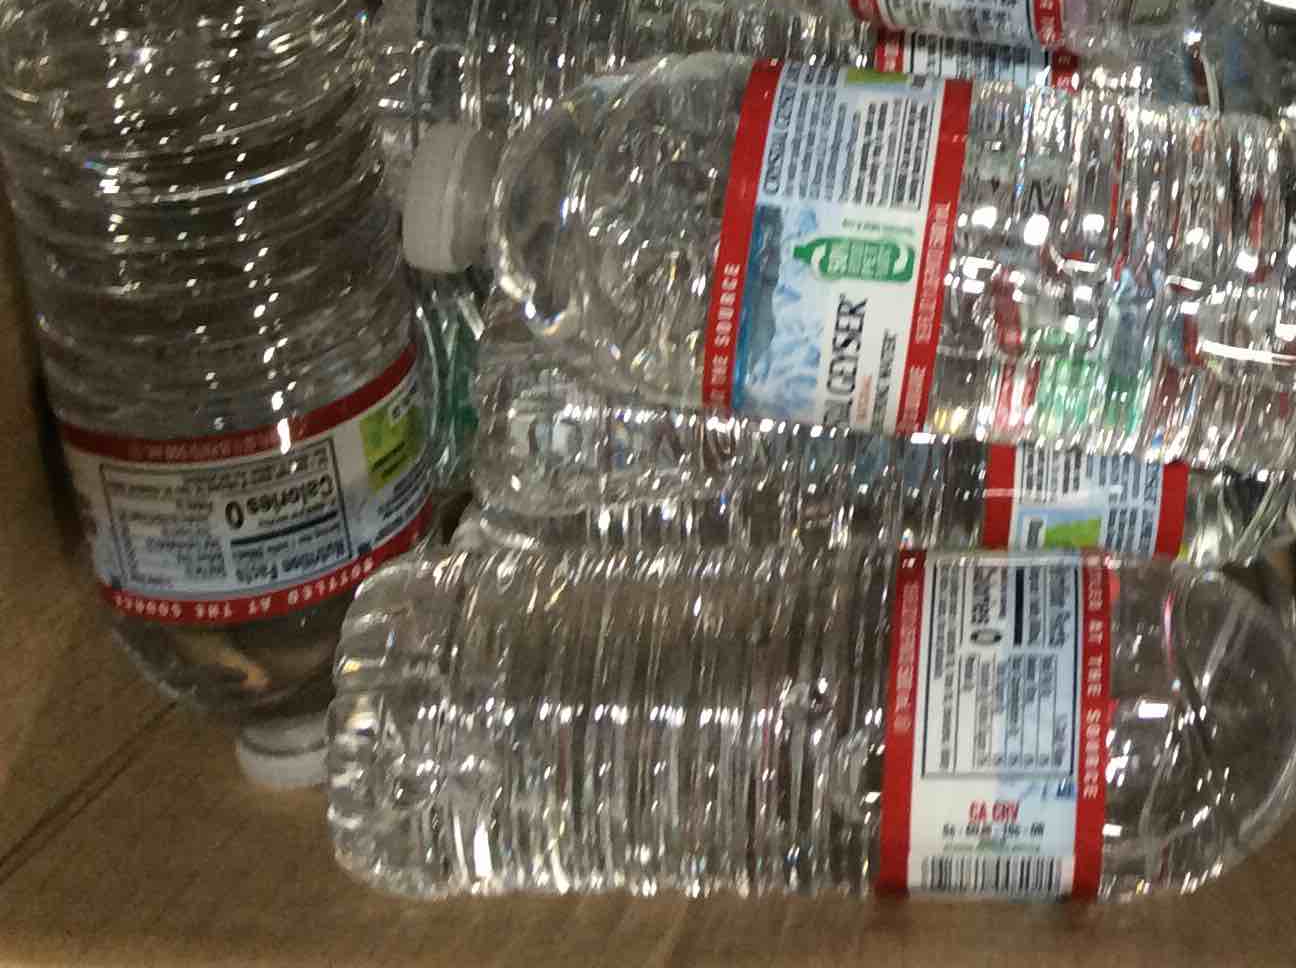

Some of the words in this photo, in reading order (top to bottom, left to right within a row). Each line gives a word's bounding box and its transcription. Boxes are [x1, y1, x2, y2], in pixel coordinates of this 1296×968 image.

[715, 263, 740, 348] SOURCE
[224, 501, 245, 529] 0
[247, 474, 335, 514] Calories
[287, 559, 373, 606] BOTTLED
